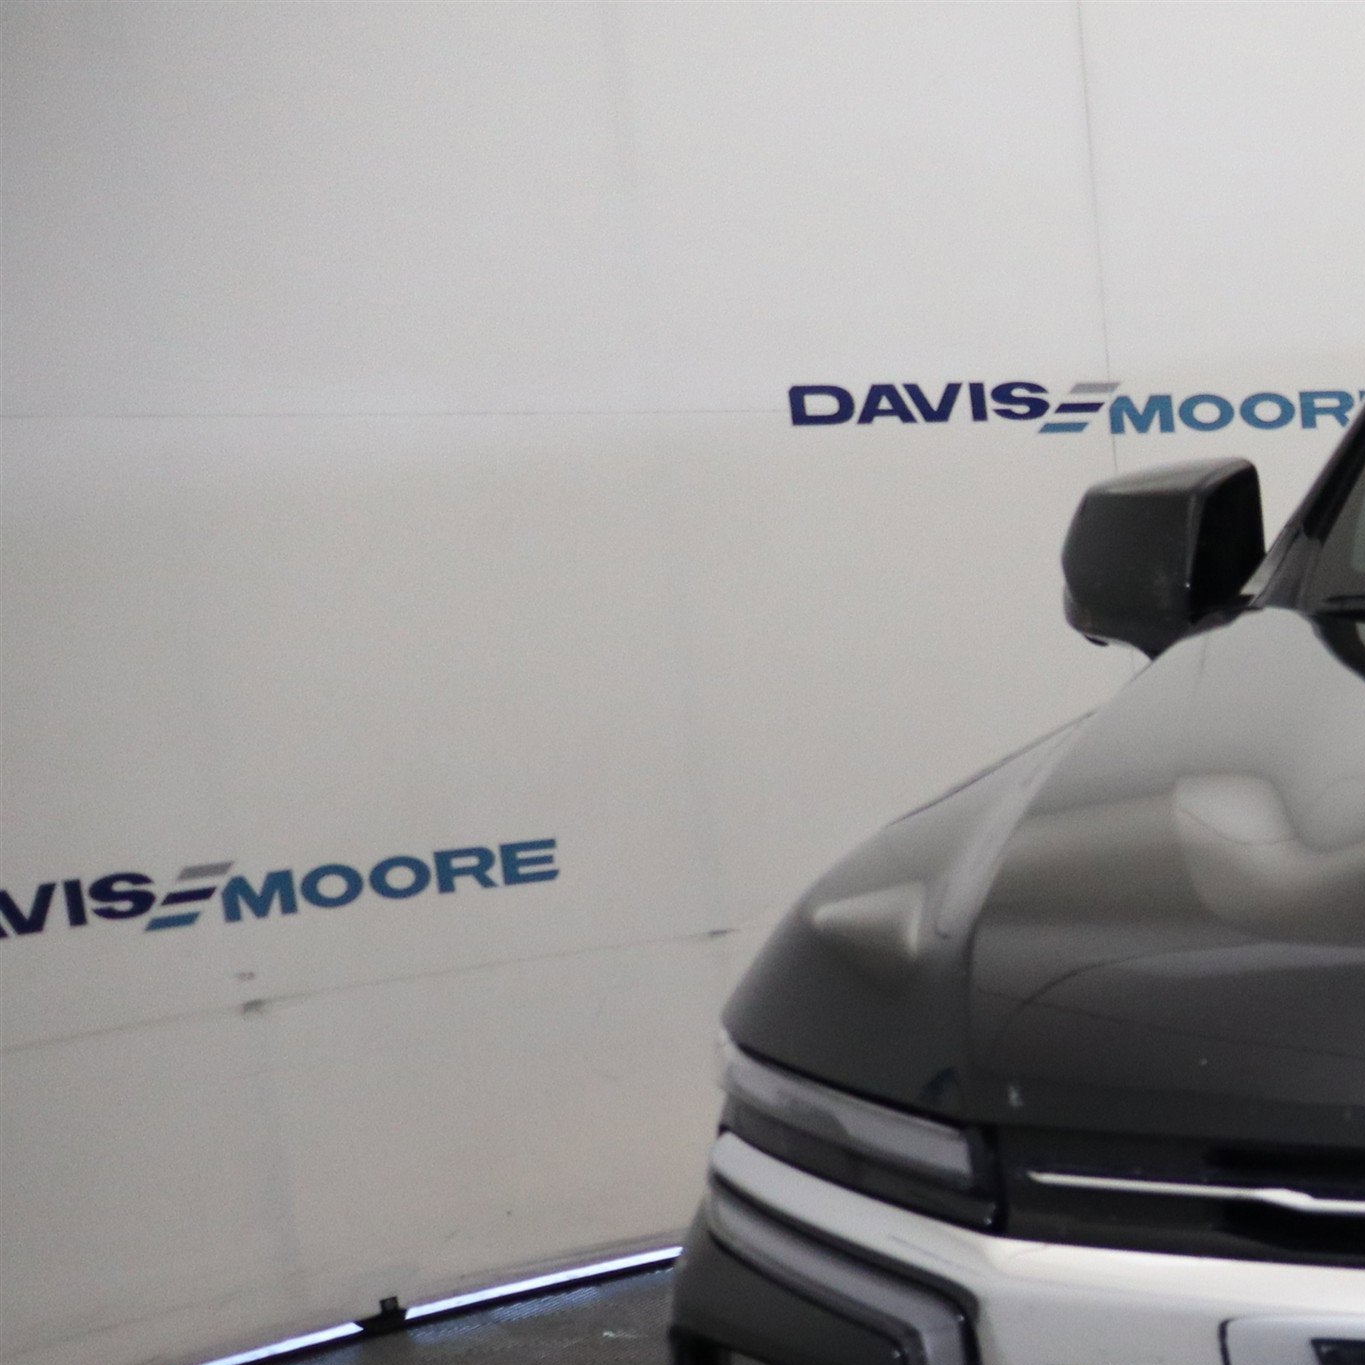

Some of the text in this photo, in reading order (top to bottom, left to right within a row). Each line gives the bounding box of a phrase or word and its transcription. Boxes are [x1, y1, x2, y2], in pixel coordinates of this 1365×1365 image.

[788, 381, 1050, 426] DAVIS
[0, 838, 560, 938] VIS MOORE
